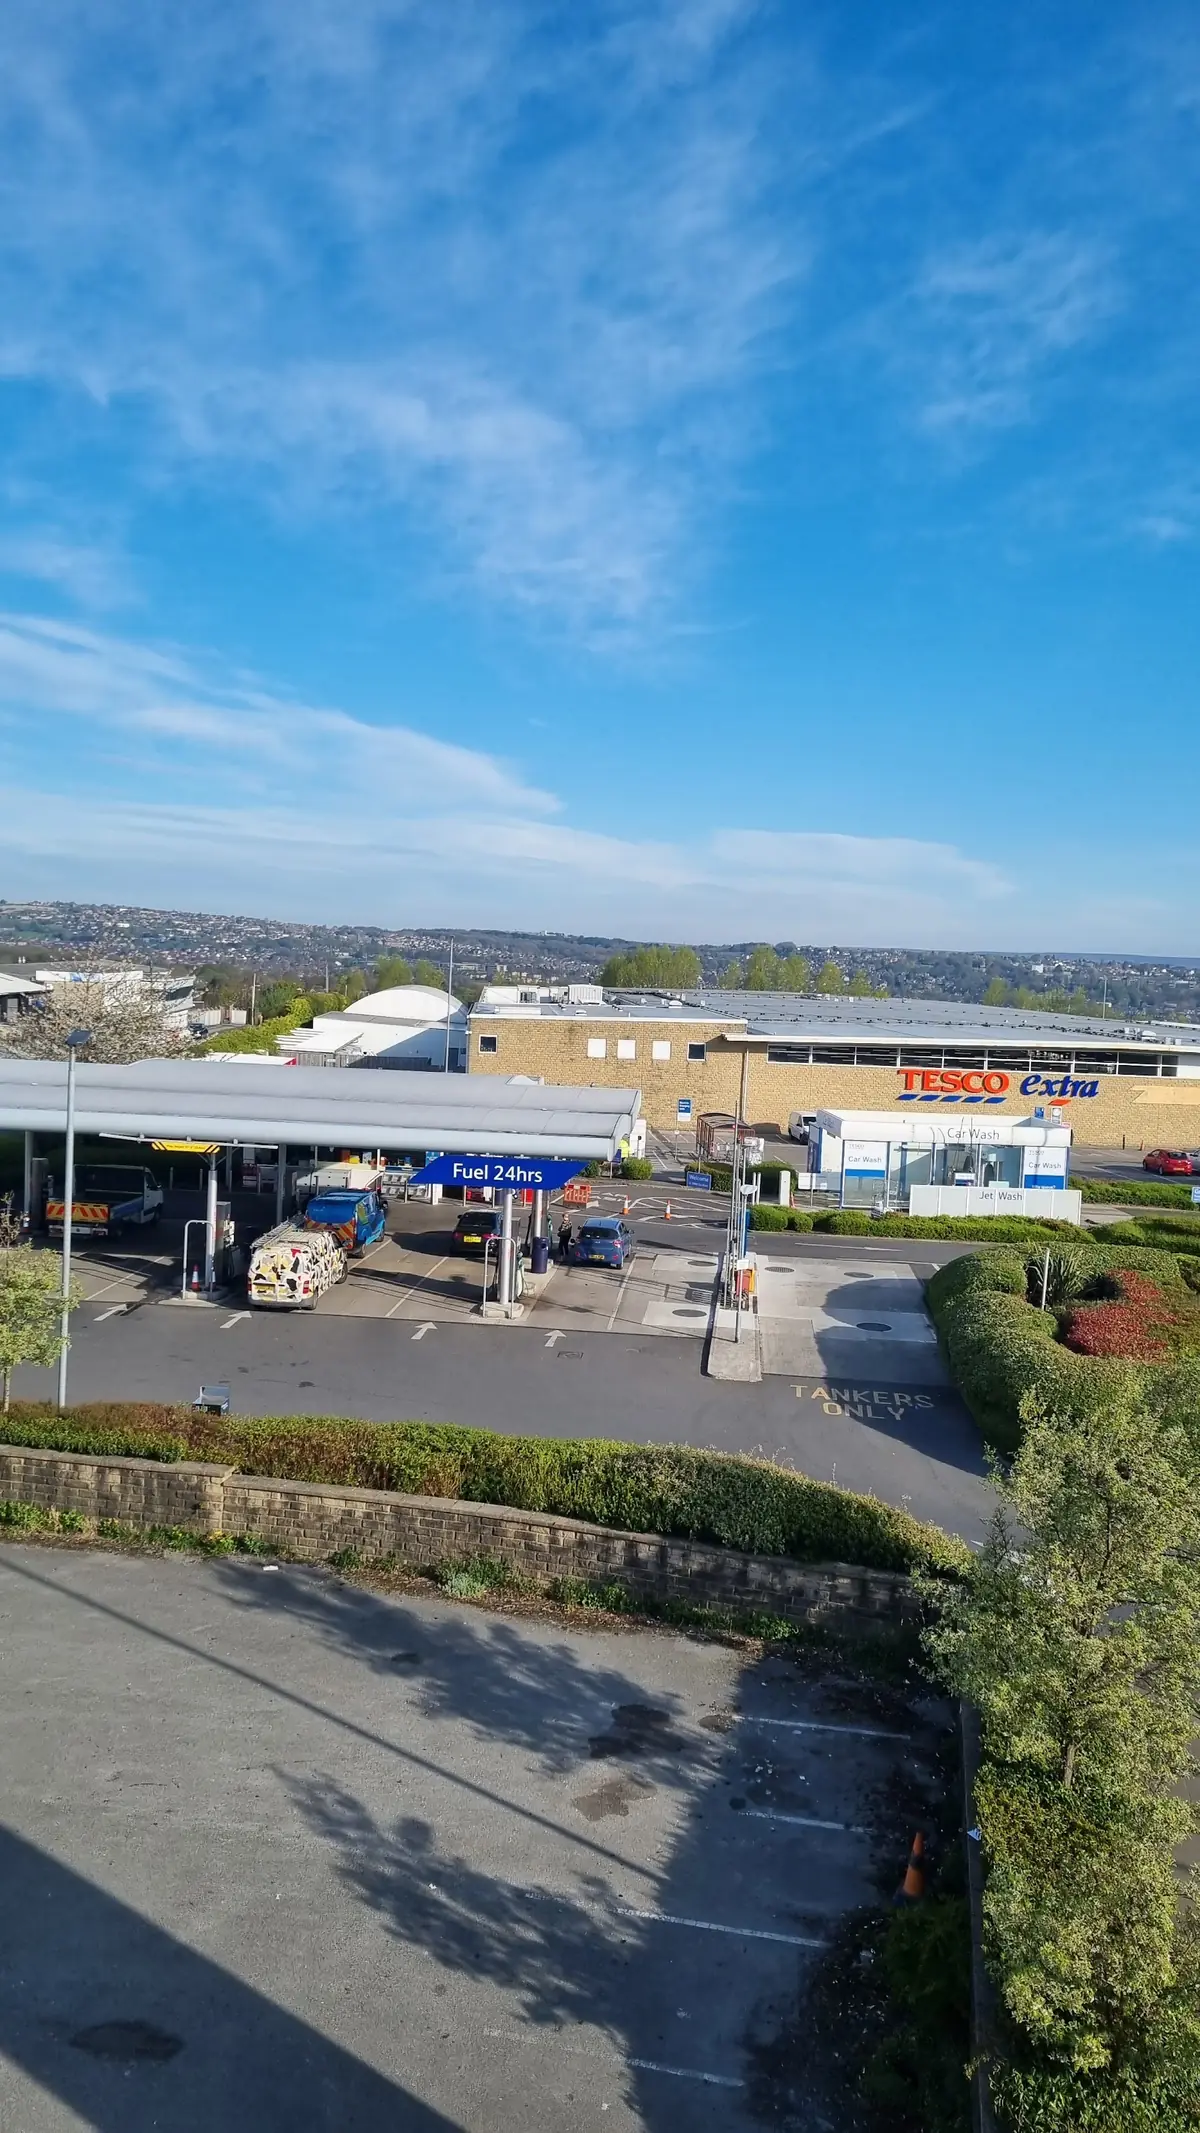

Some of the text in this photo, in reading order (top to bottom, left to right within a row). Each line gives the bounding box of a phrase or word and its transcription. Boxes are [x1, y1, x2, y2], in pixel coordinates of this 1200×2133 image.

[897, 1069, 1099, 1098] TESCO extra
[947, 1127, 1000, 1140] Car Wash
[848, 1155, 882, 1164] Car Wash
[1028, 1161, 1041, 1169] Car
[453, 1162, 543, 1183] Fuel 24hrs
[979, 1191, 1023, 1201] Jet Wash
[789, 1384, 935, 1409] TANKERS
[822, 1402, 905, 1421] ONLY
